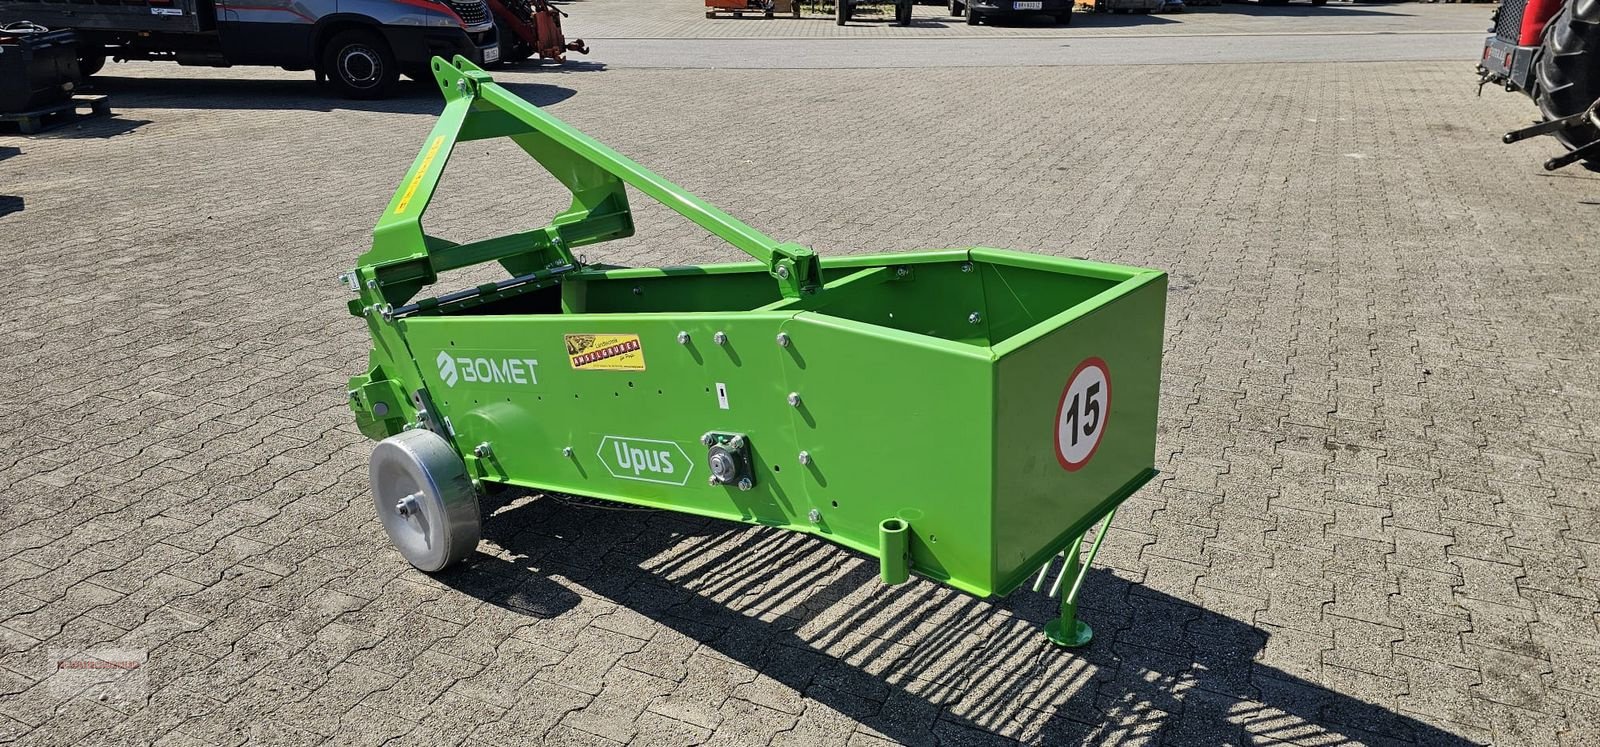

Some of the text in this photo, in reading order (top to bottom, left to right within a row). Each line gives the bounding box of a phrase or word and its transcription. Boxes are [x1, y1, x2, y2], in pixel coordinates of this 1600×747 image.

[457, 358, 538, 384] BOMET
[1066, 381, 1100, 447] 15
[613, 440, 674, 475] Upus
